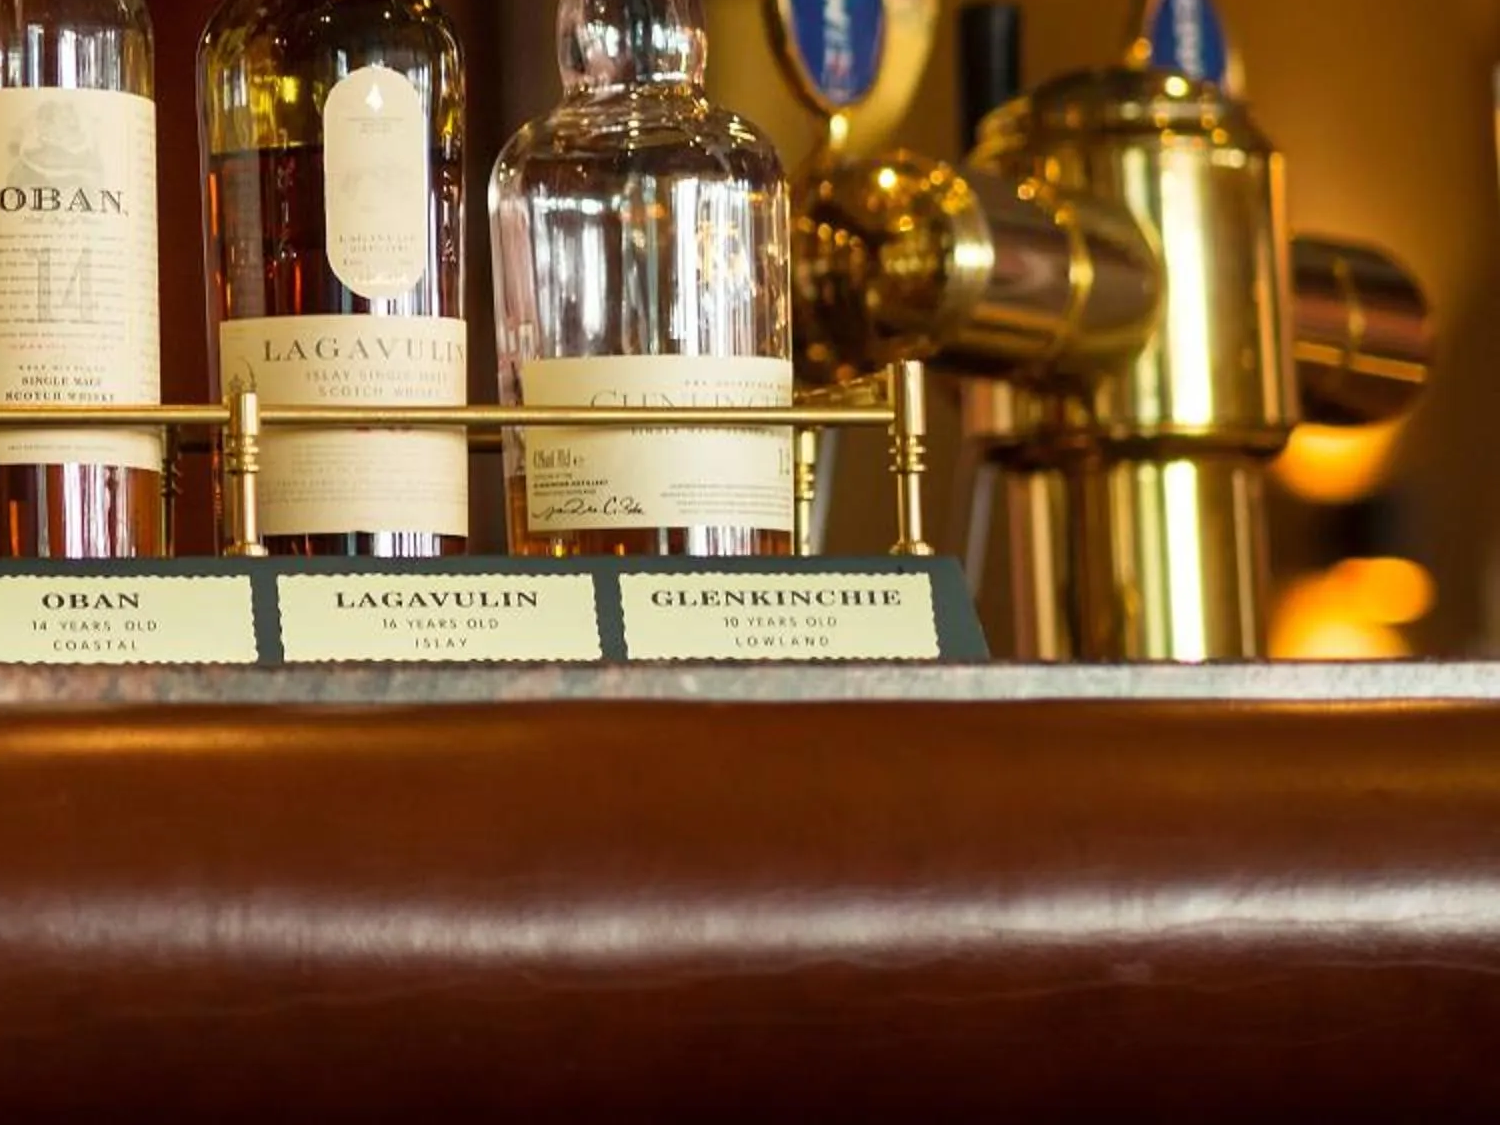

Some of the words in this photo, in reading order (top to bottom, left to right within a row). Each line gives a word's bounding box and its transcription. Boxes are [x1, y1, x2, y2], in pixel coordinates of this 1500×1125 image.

[42, 592, 140, 610] OBAN
[336, 591, 538, 608] LAGAVULIN
[651, 589, 902, 607] GLENKINCHIE
[32, 620, 47, 632] 14
[60, 620, 112, 632] YEARS
[125, 620, 158, 632] OLD
[383, 618, 398, 630] 16
[408, 618, 458, 630] YEARS
[468, 618, 499, 630] OLD
[724, 617, 739, 628] 10
[747, 616, 798, 628] YEARS
[806, 616, 838, 628] OLD
[53, 640, 138, 652] COASTAL
[415, 638, 468, 649] ISLAY
[735, 636, 830, 647] LOWLAND
